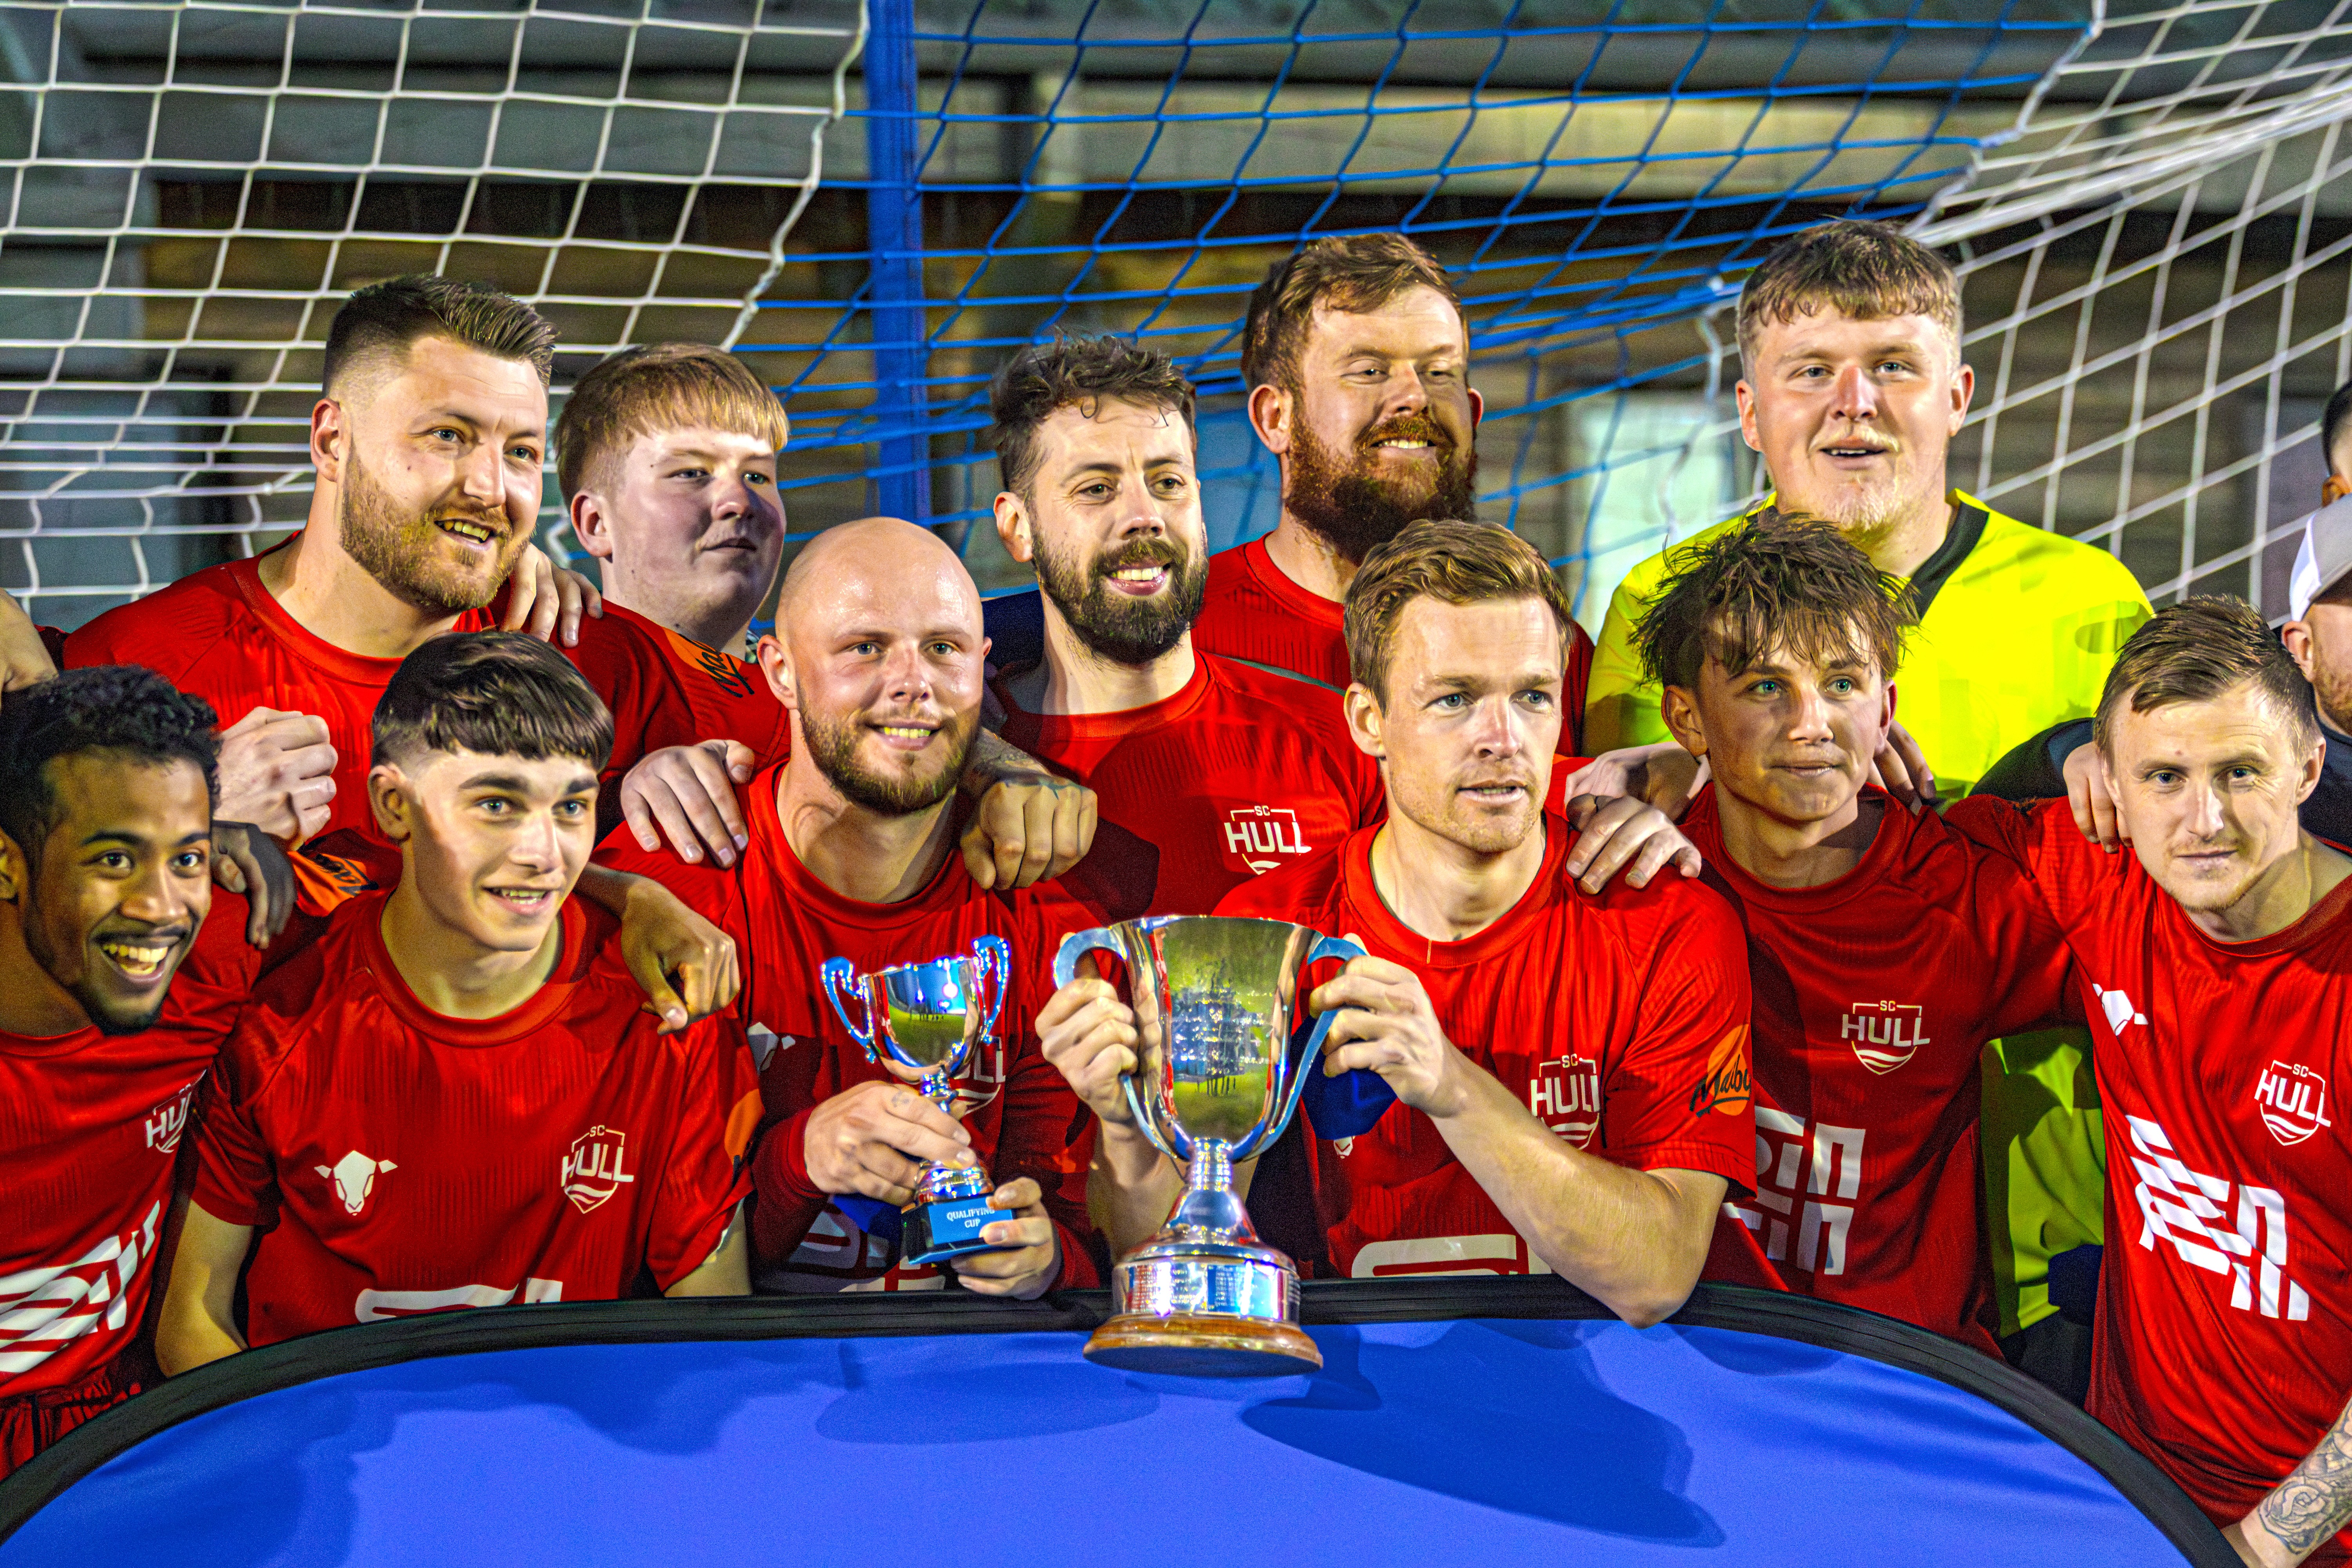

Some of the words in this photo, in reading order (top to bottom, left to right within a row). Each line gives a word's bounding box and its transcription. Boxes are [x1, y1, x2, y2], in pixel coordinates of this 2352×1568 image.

[1254, 805, 1270, 816] SC
[1224, 822, 1312, 853] HULL
[1880, 1000, 1896, 1011] SC
[1842, 1014, 1930, 1047] HULL
[1562, 1053, 1578, 1068] SC
[2293, 1063, 2309, 1078] SC
[2254, 1069, 2331, 1127] HULL
[590, 1125, 605, 1137] SC
[561, 1143, 634, 1187] HULL
[947, 1207, 995, 1221] QUALIFYING
[964, 1218, 981, 1228] CUP
